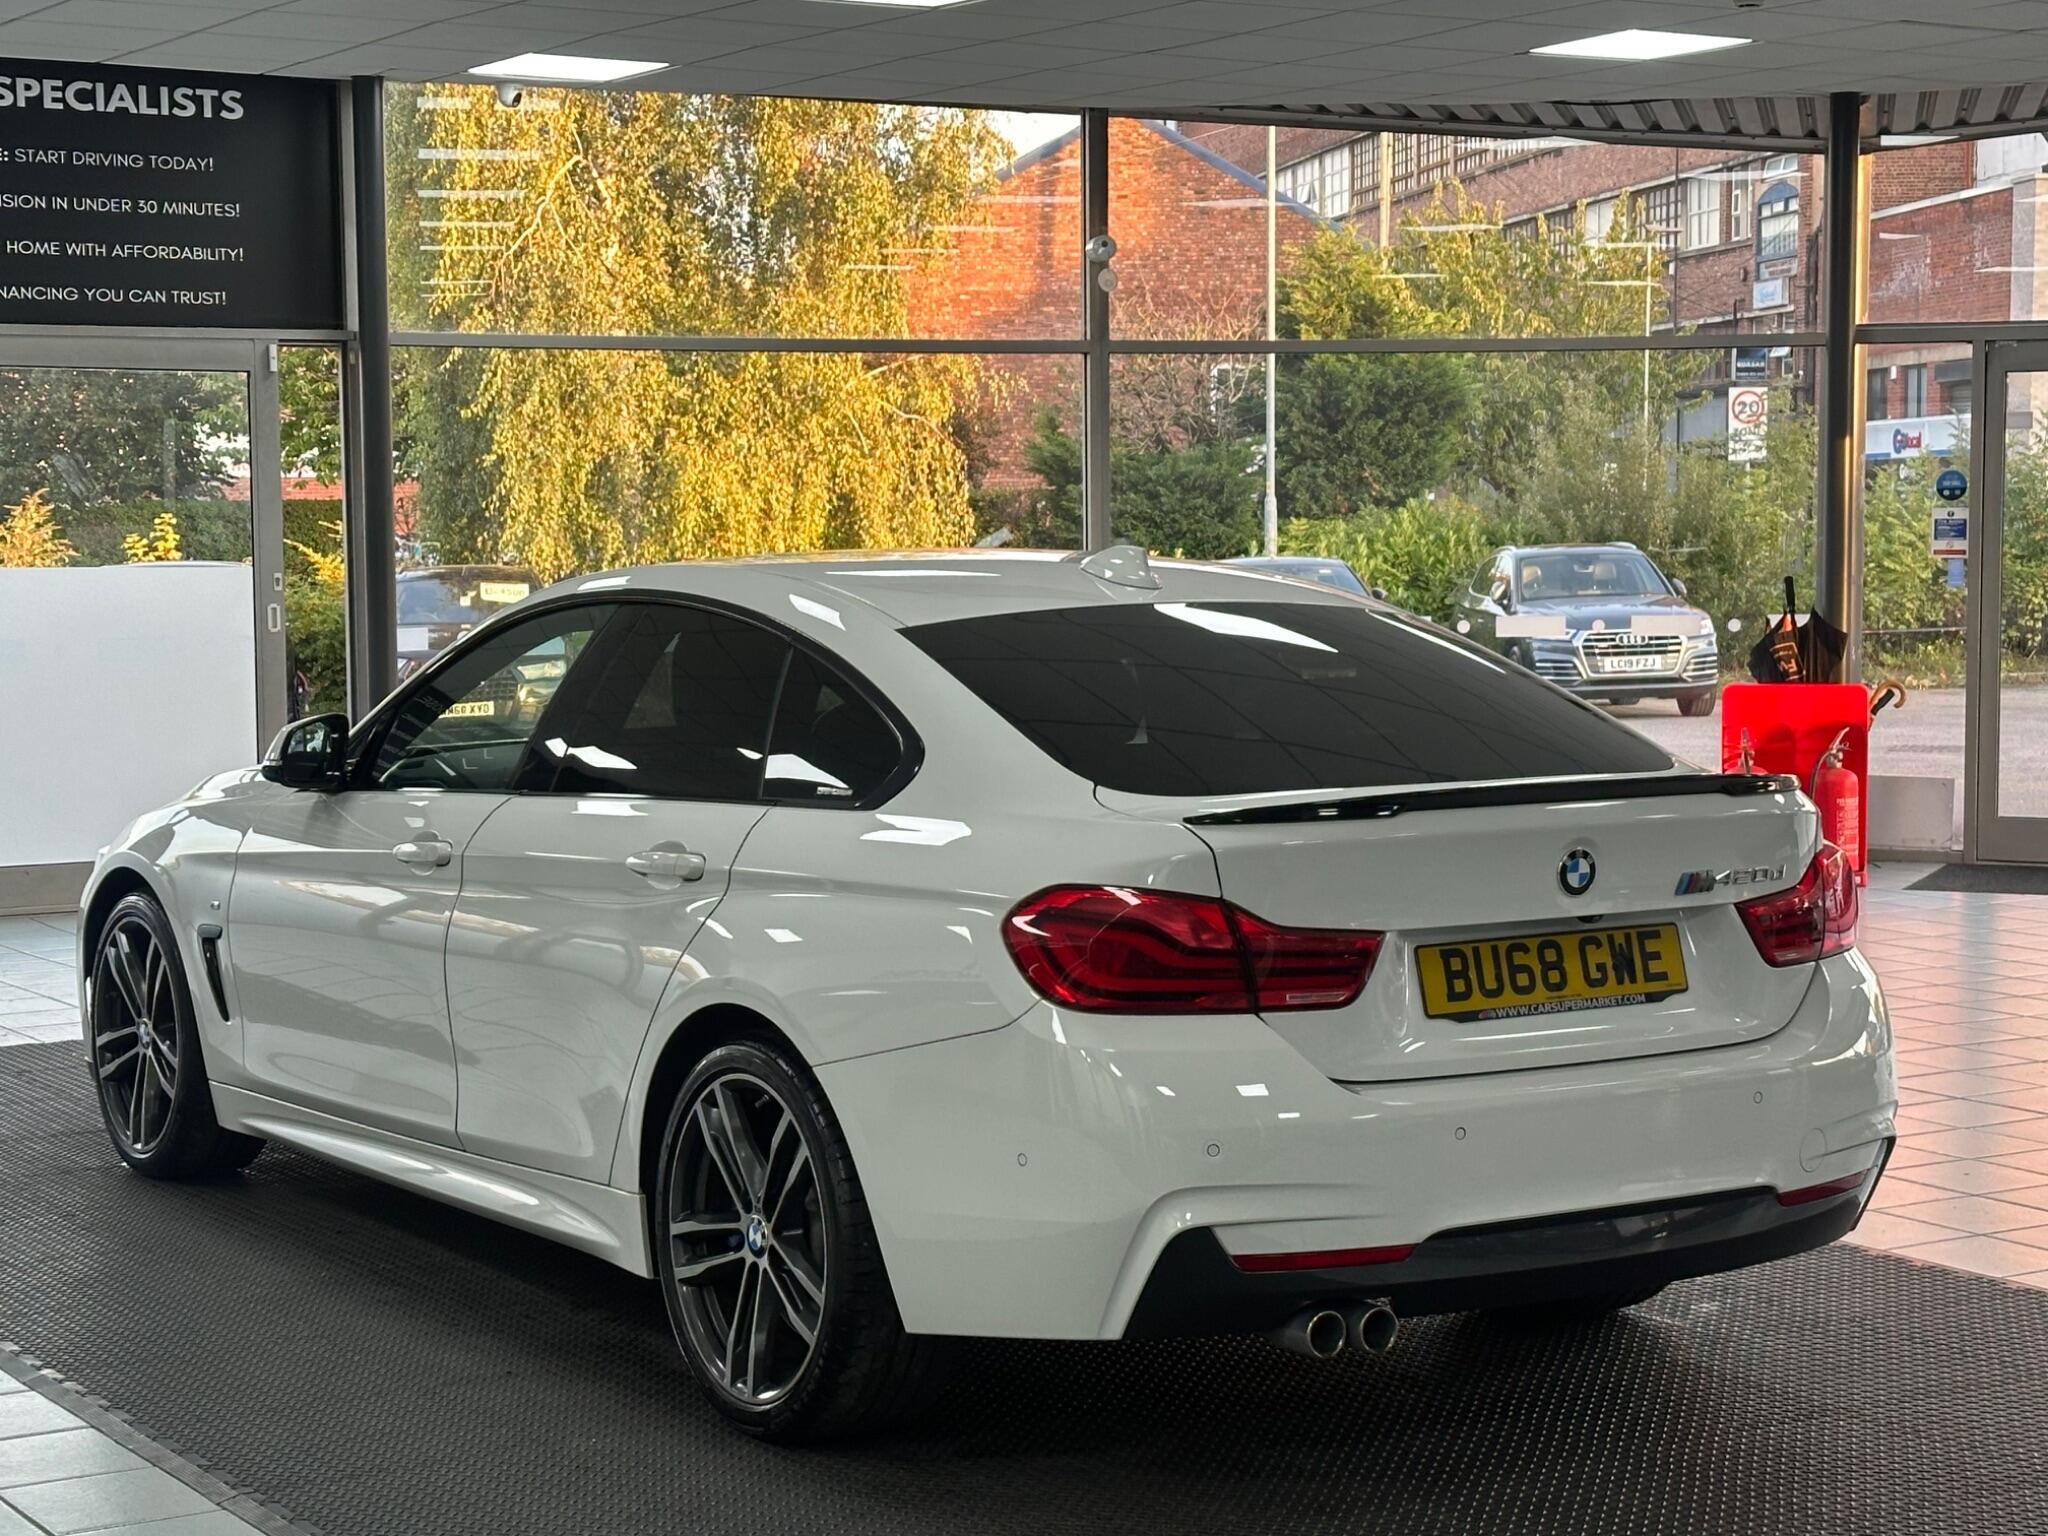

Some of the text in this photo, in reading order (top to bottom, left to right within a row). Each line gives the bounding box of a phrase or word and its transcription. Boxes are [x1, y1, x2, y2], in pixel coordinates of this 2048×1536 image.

[0, 76, 244, 120] SPECIALISTS
[14, 148, 67, 164] START
[72, 151, 144, 168] DRIVING
[149, 155, 214, 172] TODAY!
[51, 195, 68, 210] IN
[73, 197, 132, 213] UNDER
[137, 200, 158, 214] 30
[162, 201, 240, 218] MINUTES!
[6, 240, 244, 262] HOME WITH AFFORDABILITY!
[83, 288, 124, 302] YOU
[128, 289, 166, 303] CAN
[170, 290, 226, 305] TRUST!
[1737, 400, 1760, 415] 20
[1439, 929, 1669, 1003] BU68 GWE
[1495, 993, 1647, 1018] WWW.CARSUPERMARKET.COM
